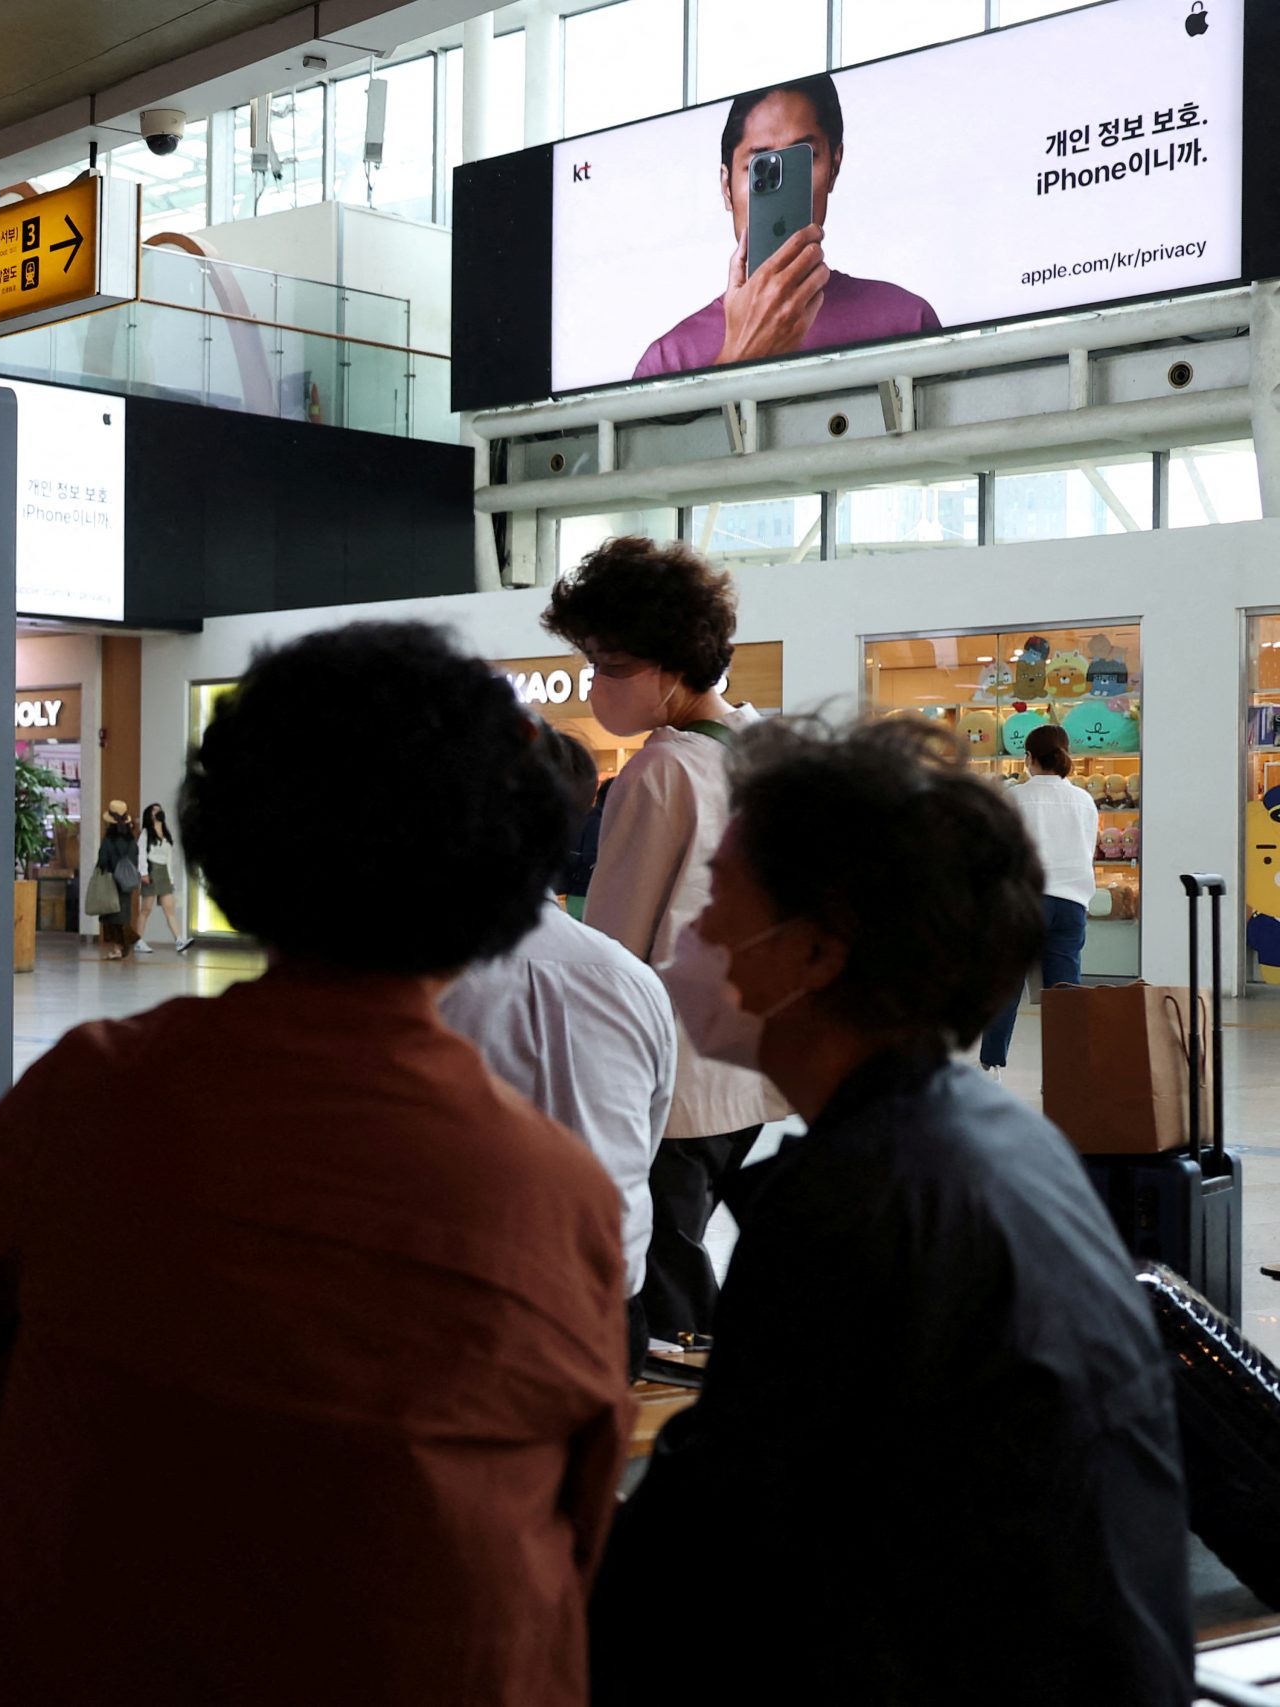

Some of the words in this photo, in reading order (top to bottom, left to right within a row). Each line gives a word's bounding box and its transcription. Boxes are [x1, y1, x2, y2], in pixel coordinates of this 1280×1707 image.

[1046, 124, 1090, 157] 개인
[1098, 114, 1145, 148] 정보
[1151, 101, 1208, 135] 보호.
[573, 161, 592, 183] kt
[1036, 137, 1208, 196] iPhone이니까.
[26, 223, 36, 246] 3
[1021, 240, 1207, 286] apple.com/kr/privacy
[28, 479, 52, 498] 개인
[58, 482, 80, 500] 정보
[507, 669, 573, 704] KAO
[15, 700, 62, 727] OLY
